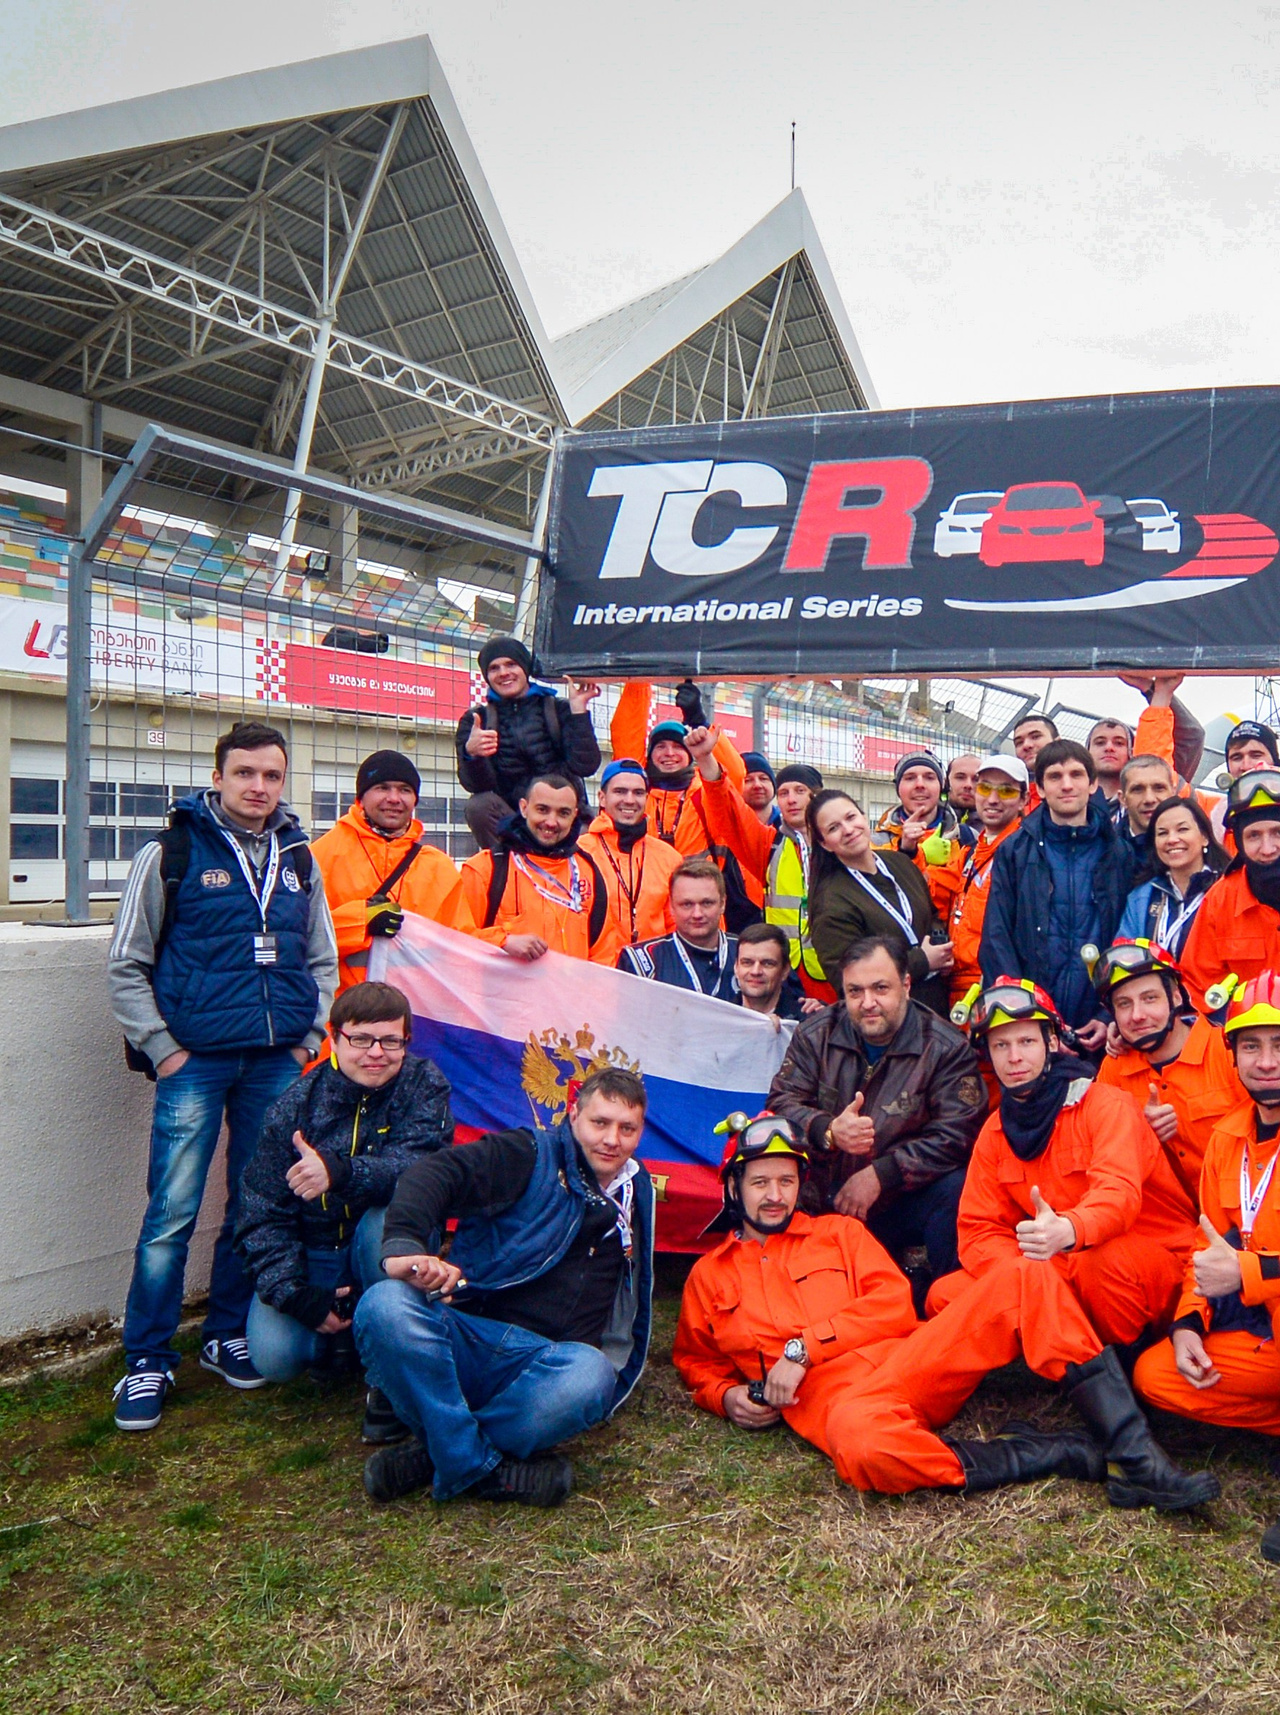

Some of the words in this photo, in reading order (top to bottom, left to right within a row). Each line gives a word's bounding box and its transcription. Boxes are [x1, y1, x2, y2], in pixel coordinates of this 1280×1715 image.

[587, 455, 934, 579] TCR
[572, 597, 794, 625] International
[800, 594, 924, 620] Series
[163, 659, 204, 678] BANK
[149, 731, 165, 744] 39
[202, 873, 228, 886] FIA
